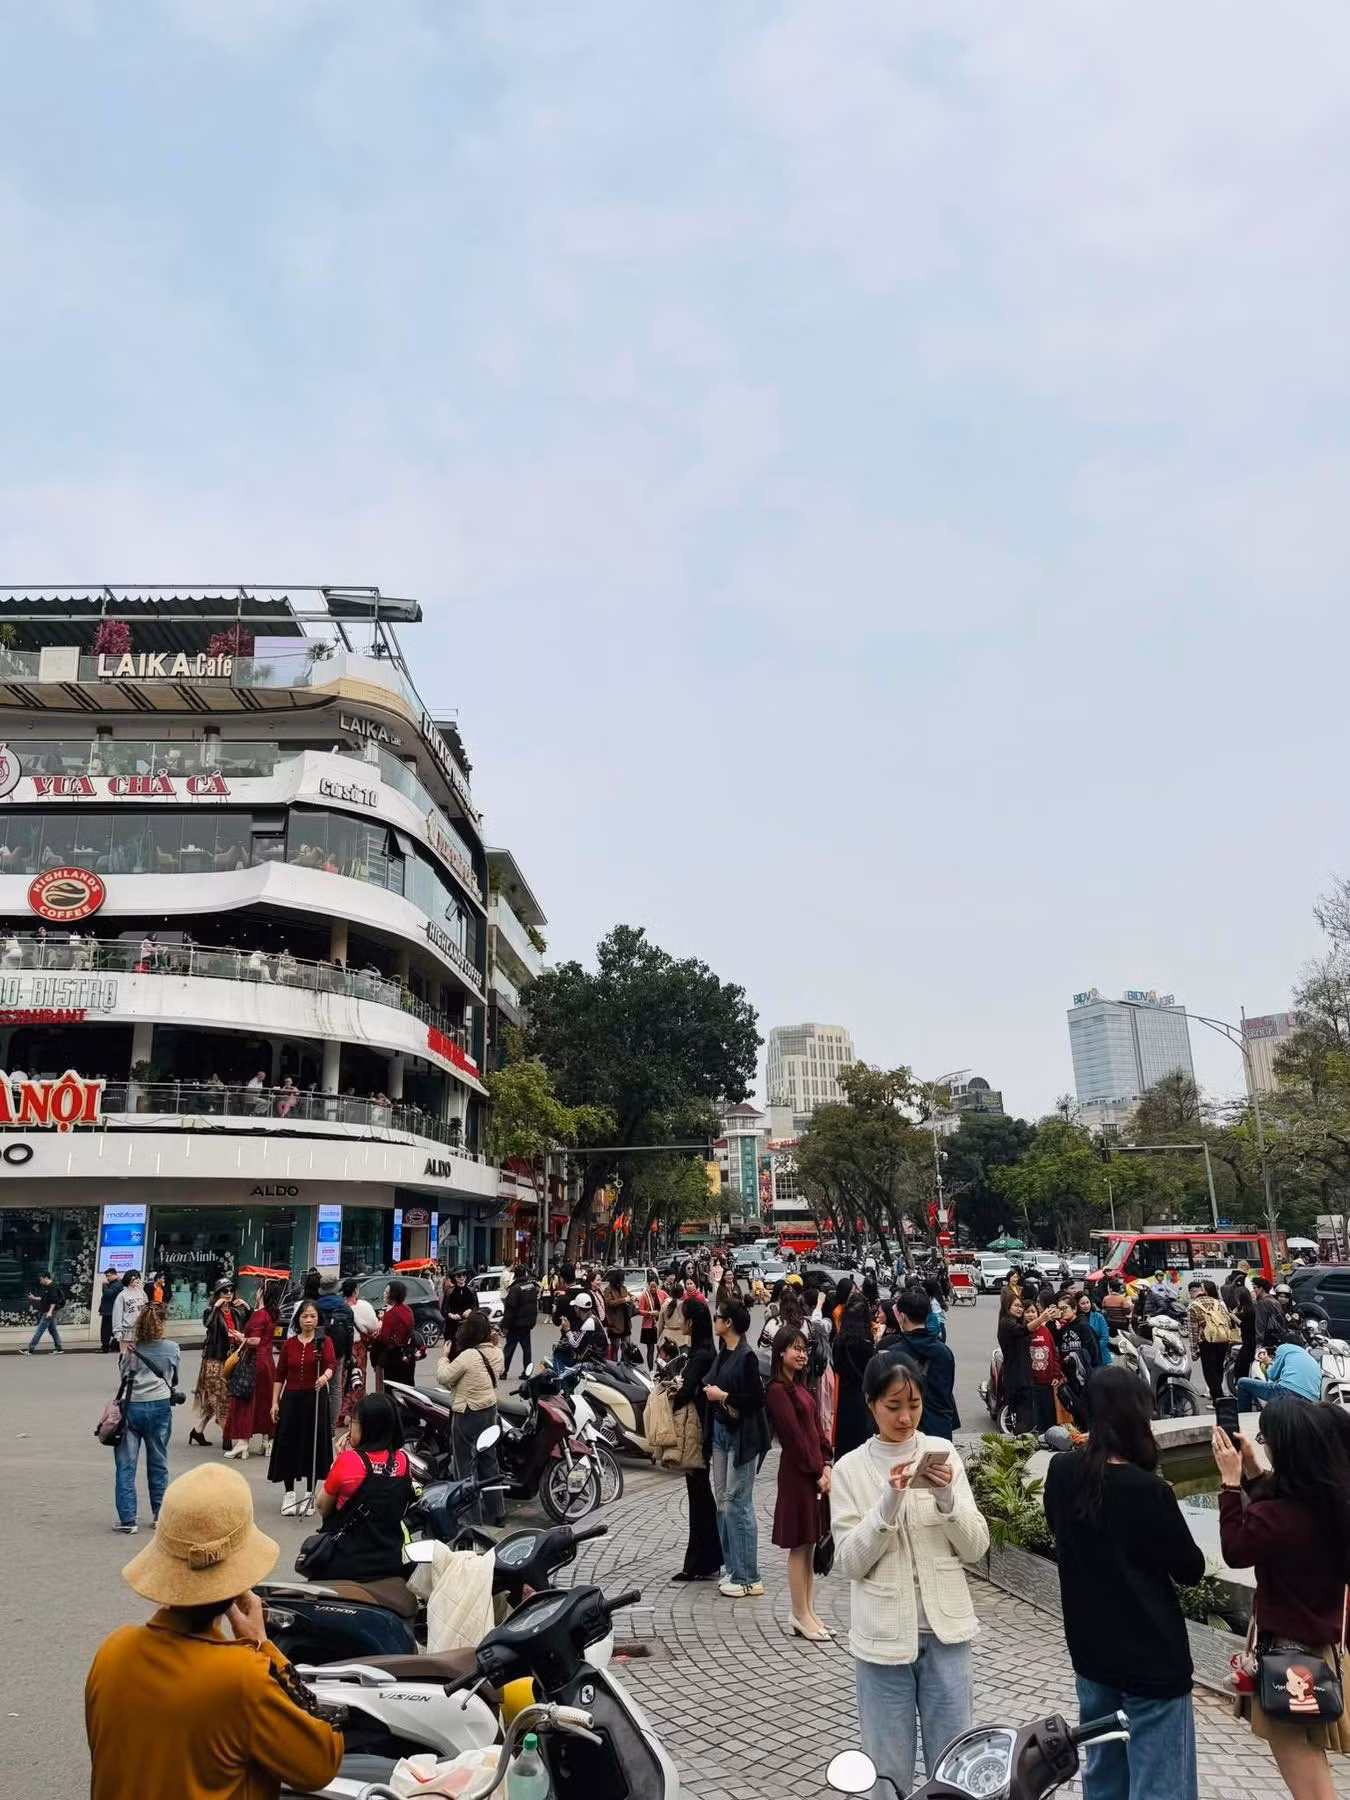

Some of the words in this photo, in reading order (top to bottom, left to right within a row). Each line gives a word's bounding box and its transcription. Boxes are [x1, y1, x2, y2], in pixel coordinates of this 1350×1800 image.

[97, 652, 191, 677] LAIKA
[197, 652, 233, 677] Café
[339, 711, 389, 743] LAIKA
[32, 775, 98, 796] VUA
[107, 768, 177, 796] CHẢ
[186, 769, 231, 796] CÁ
[33, 870, 100, 892] HIGHLANDS
[39, 905, 91, 919] COFFEE
[30, 977, 119, 1009] BISTRO
[1127, 990, 1149, 1002] BIDV
[424, 1158, 452, 1178] ALDO
[250, 1186, 299, 1197] ALDO
[313, 1604, 358, 1615] VISION
[379, 1692, 432, 1703] VISION
